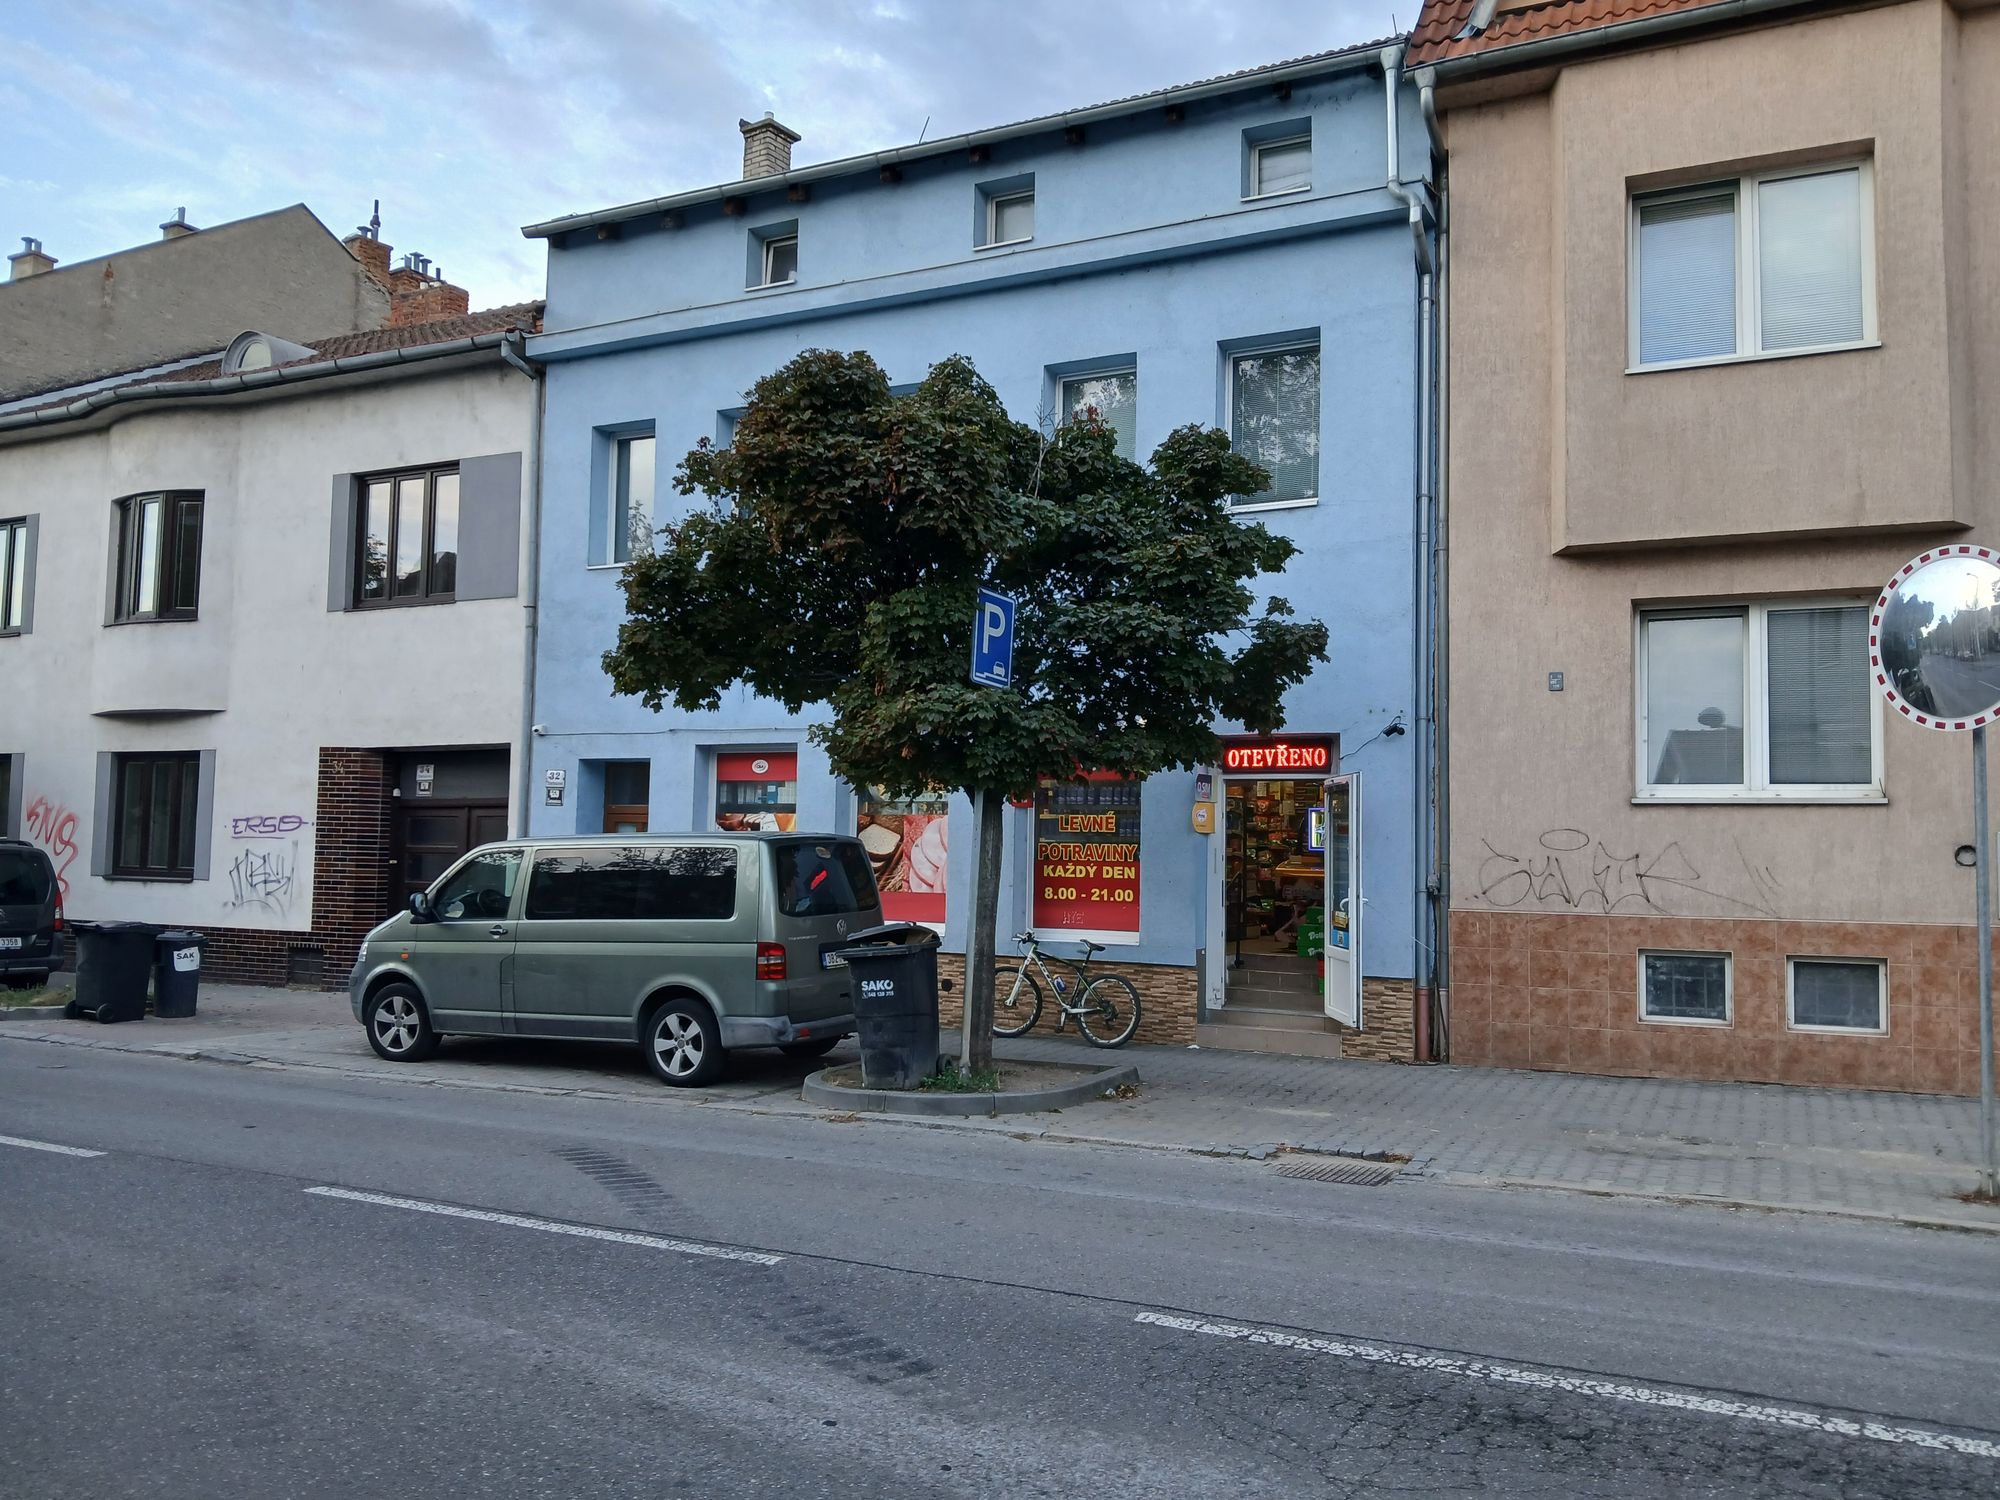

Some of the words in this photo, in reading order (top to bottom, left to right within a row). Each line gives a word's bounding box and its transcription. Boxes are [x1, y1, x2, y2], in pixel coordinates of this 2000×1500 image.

[983, 602, 1006, 654] P
[1228, 745, 1326, 767] OTEVŘENO
[549, 772, 560, 780] 32
[1059, 811, 1116, 832] LEVNÉ
[1038, 843, 1138, 861] POTRAVINY
[1043, 863, 1097, 878] KAŽDÝ
[1102, 866, 1135, 879] DEN
[1044, 887, 1077, 900] 8.00
[1091, 888, 1134, 902] 21.00
[861, 979, 894, 992] SAKO
